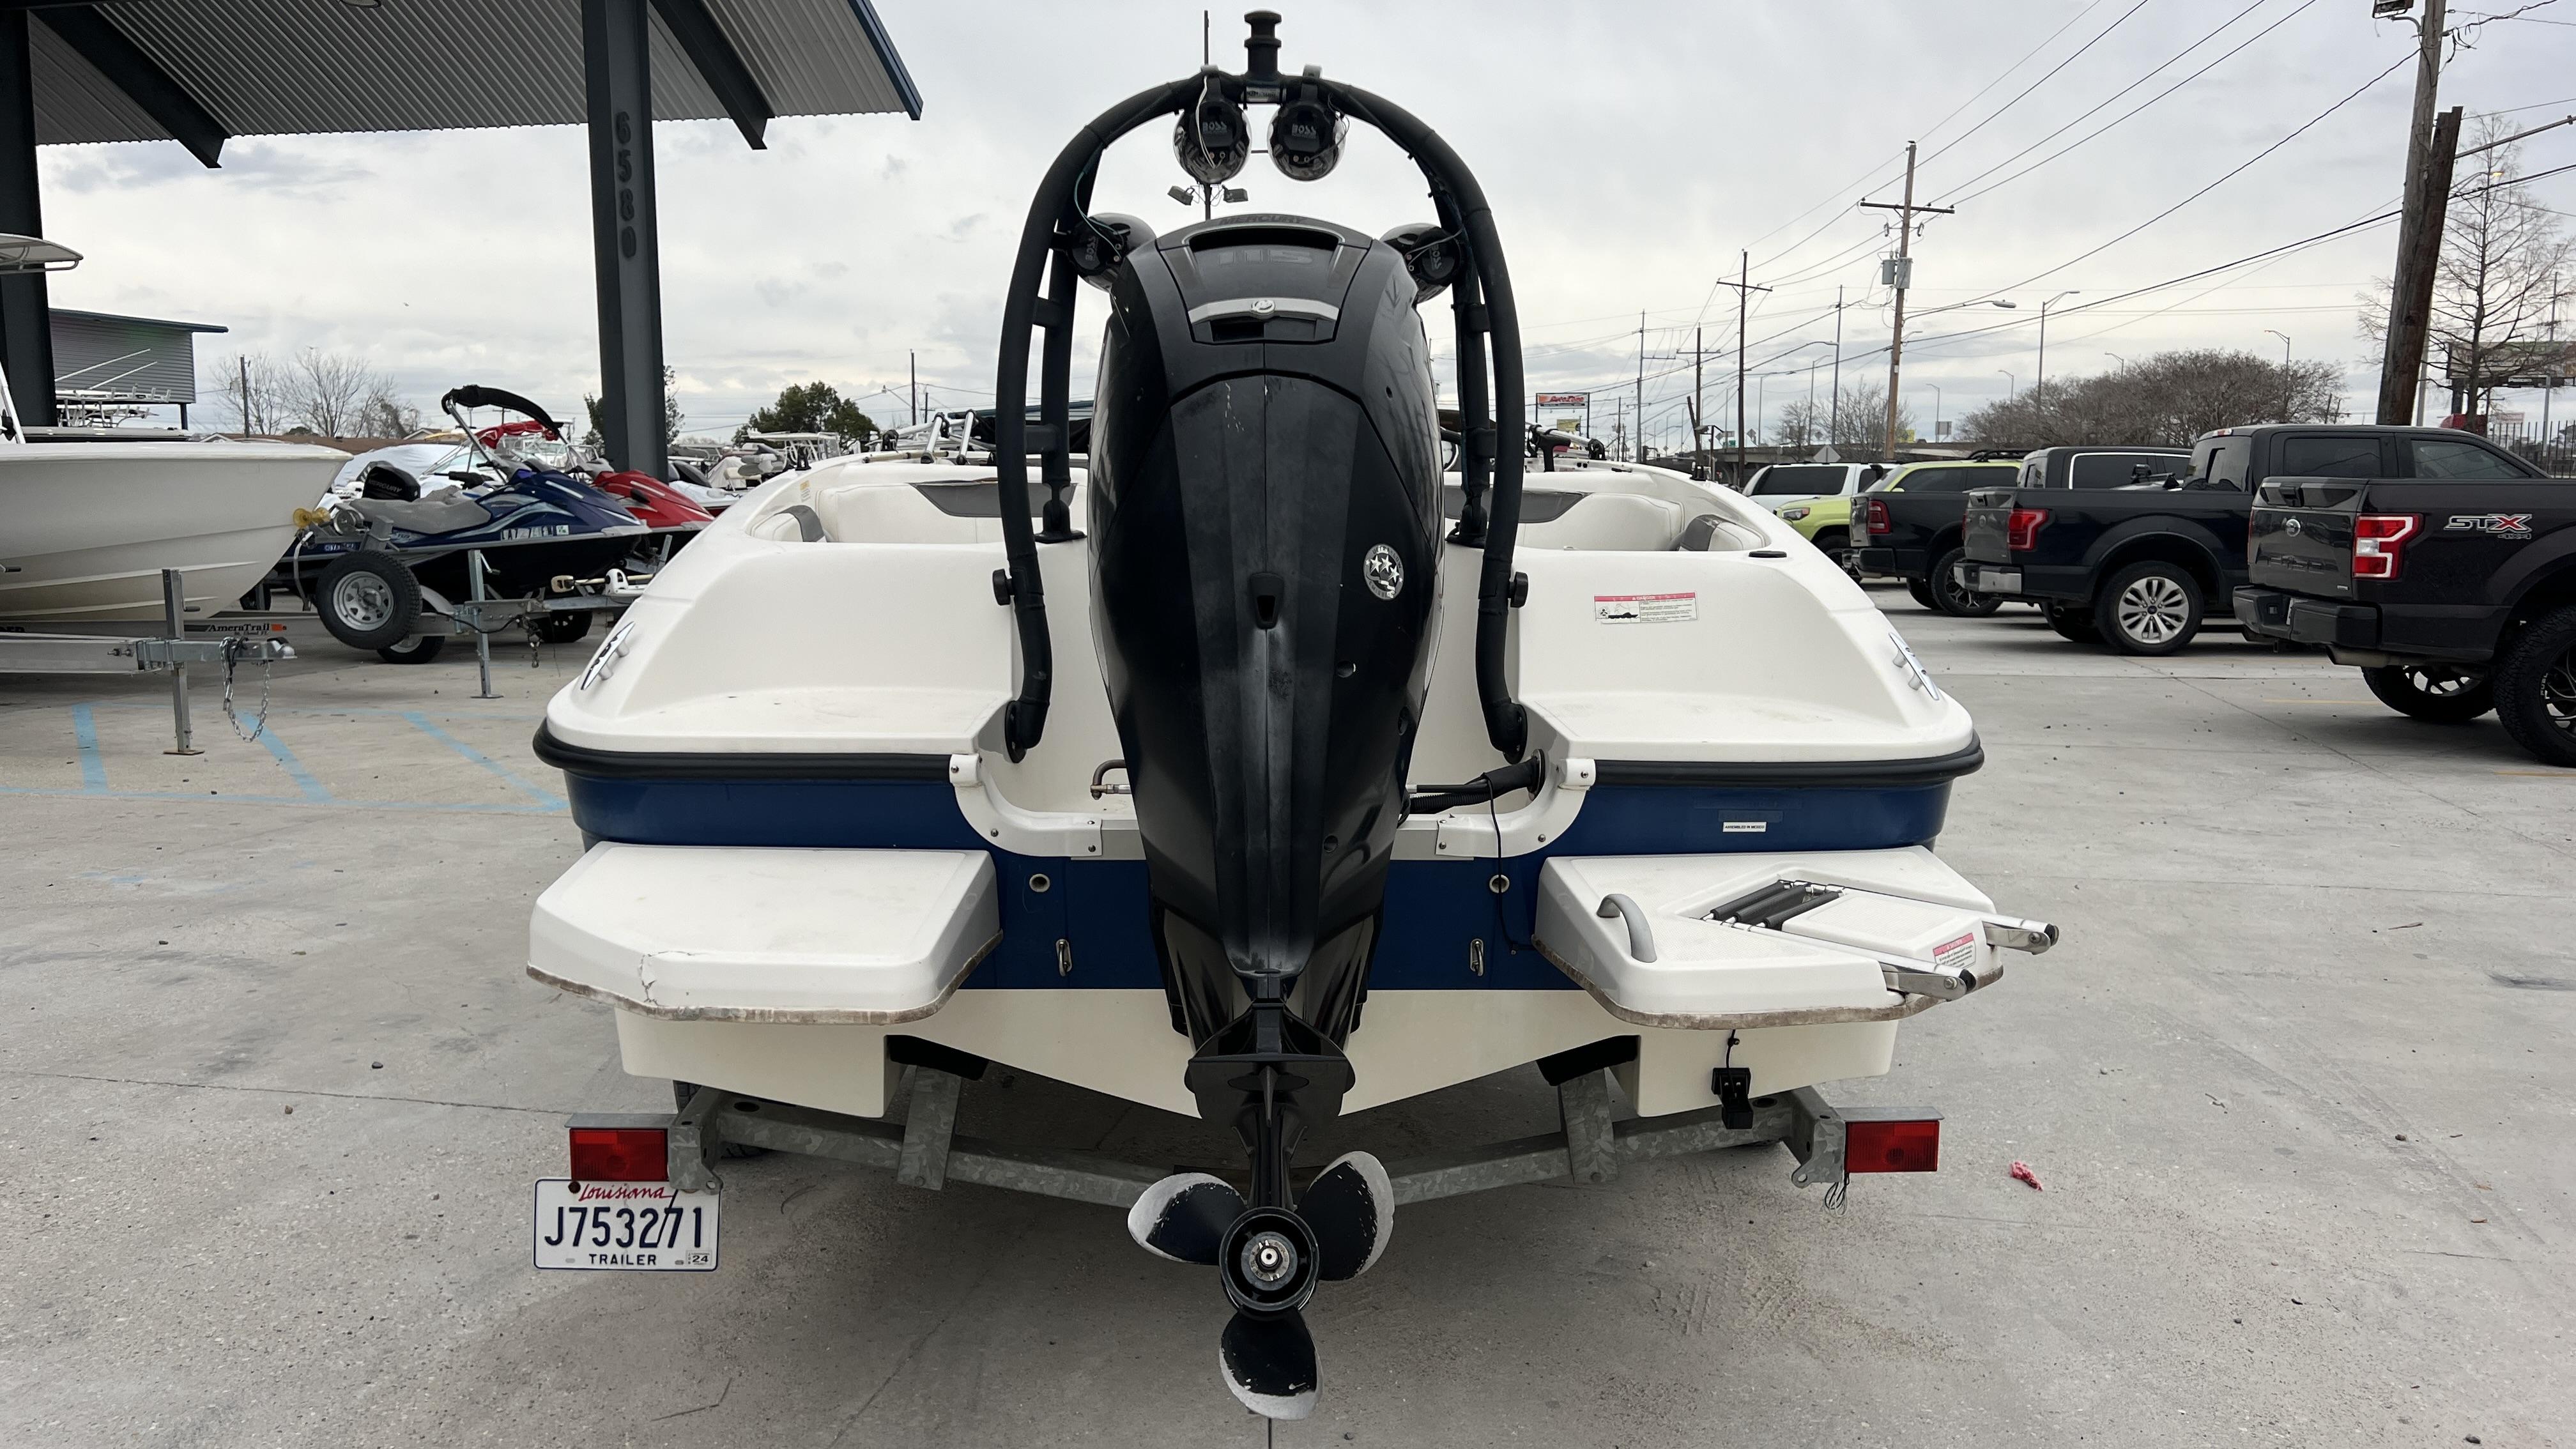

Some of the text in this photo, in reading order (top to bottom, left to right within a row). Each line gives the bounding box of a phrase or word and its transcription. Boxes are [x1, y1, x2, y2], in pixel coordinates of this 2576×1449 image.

[1202, 121, 1227, 132] BOSS
[1292, 124, 1317, 135] BOSS
[616, 111, 636, 258] 6580
[1219, 213, 1308, 224] MERCURY
[1085, 235, 1096, 261] BOSS
[1431, 244, 1442, 270] BOSS
[2443, 513, 2533, 533] STX
[2540, 673, 2549, 696] FUEL
[578, 1183, 674, 1202] Louisiana
[544, 1206, 702, 1248] J753271
[588, 1253, 657, 1266] TRAILER
[692, 1255, 709, 1263] 24
